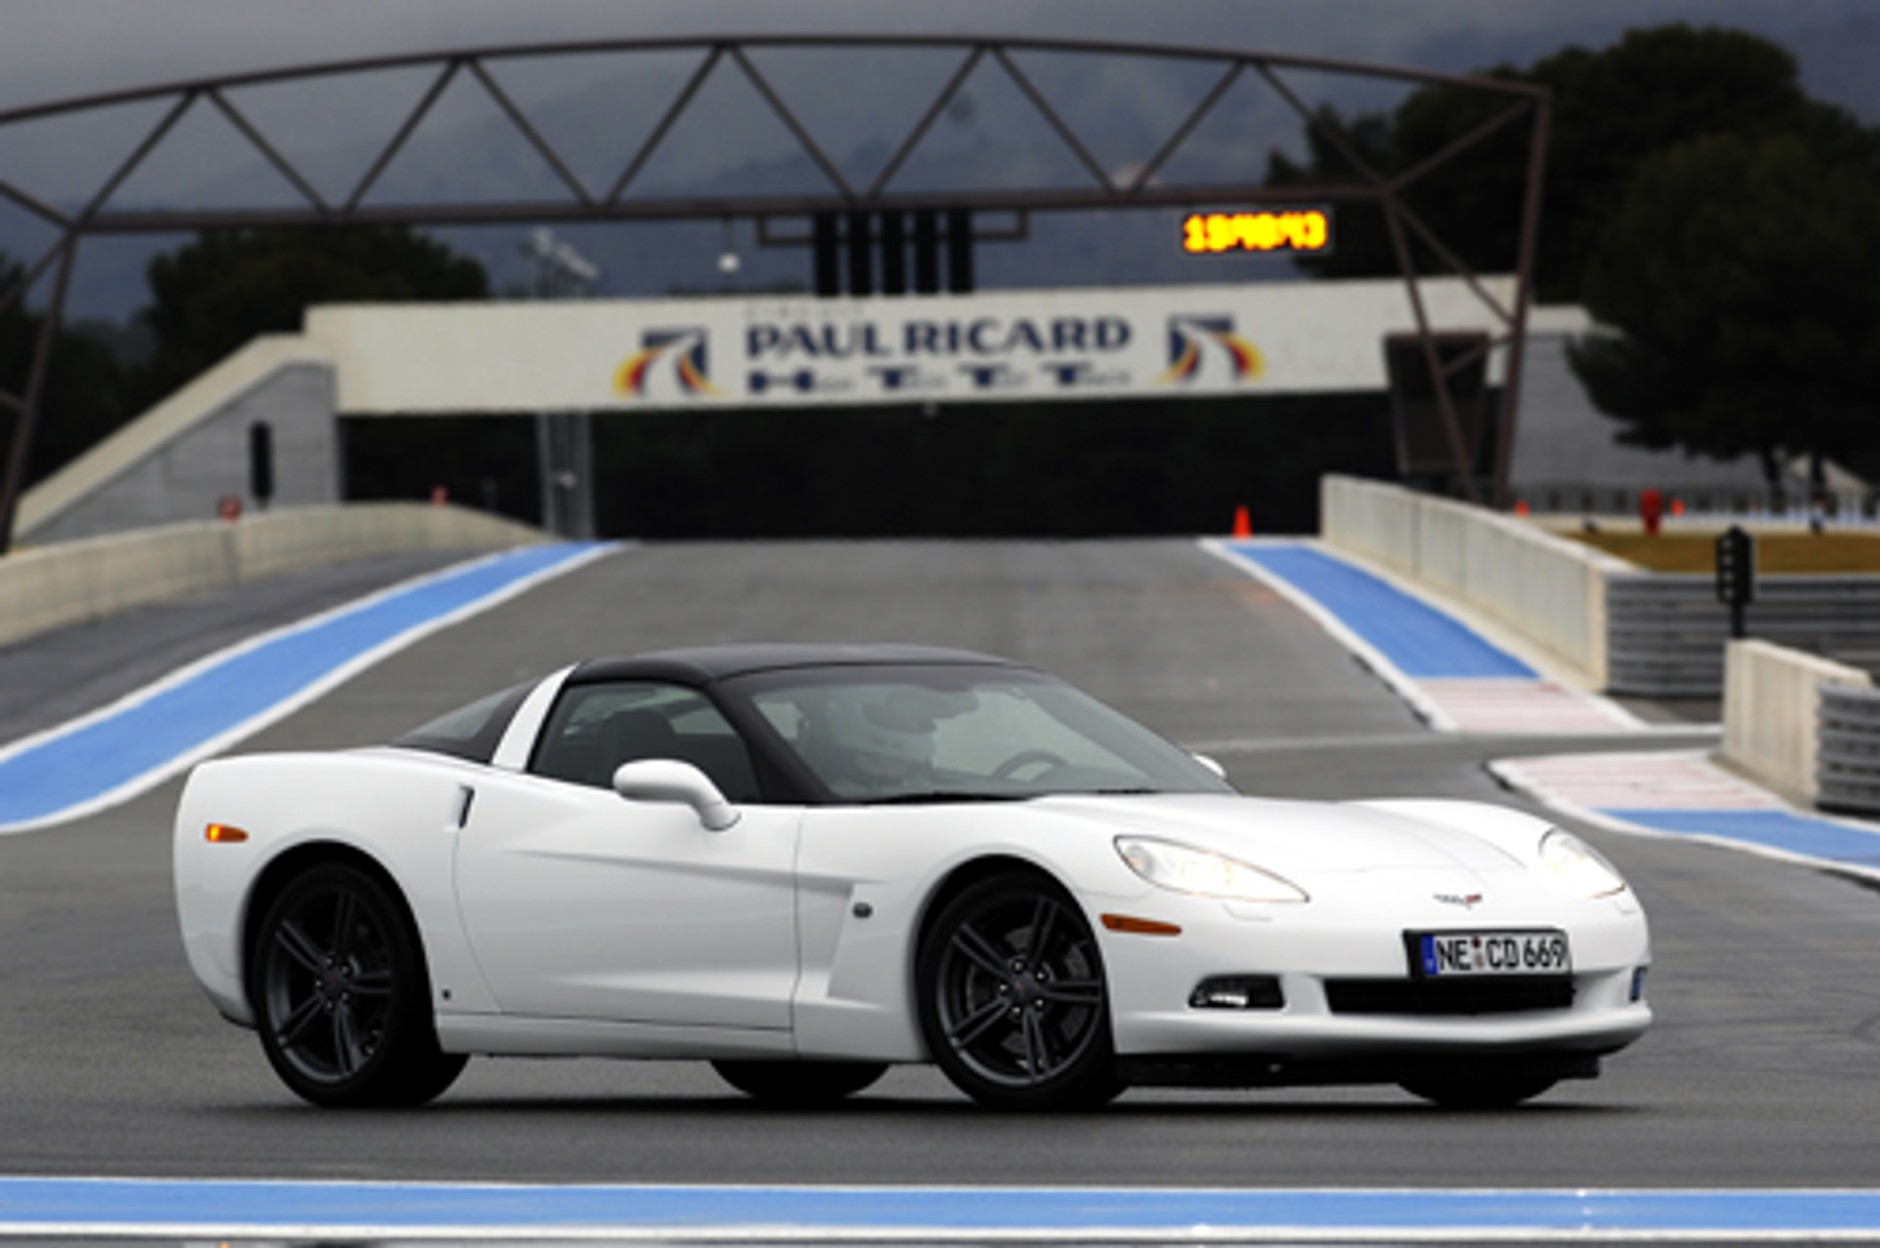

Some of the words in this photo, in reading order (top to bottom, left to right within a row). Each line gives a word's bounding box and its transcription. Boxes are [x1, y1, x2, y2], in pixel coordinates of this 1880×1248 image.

[746, 321, 892, 360] PAUL
[904, 314, 1133, 356] RICARD
[1436, 939, 1471, 970] NE
[1486, 937, 1520, 968] CD
[1523, 936, 1564, 968] 669
